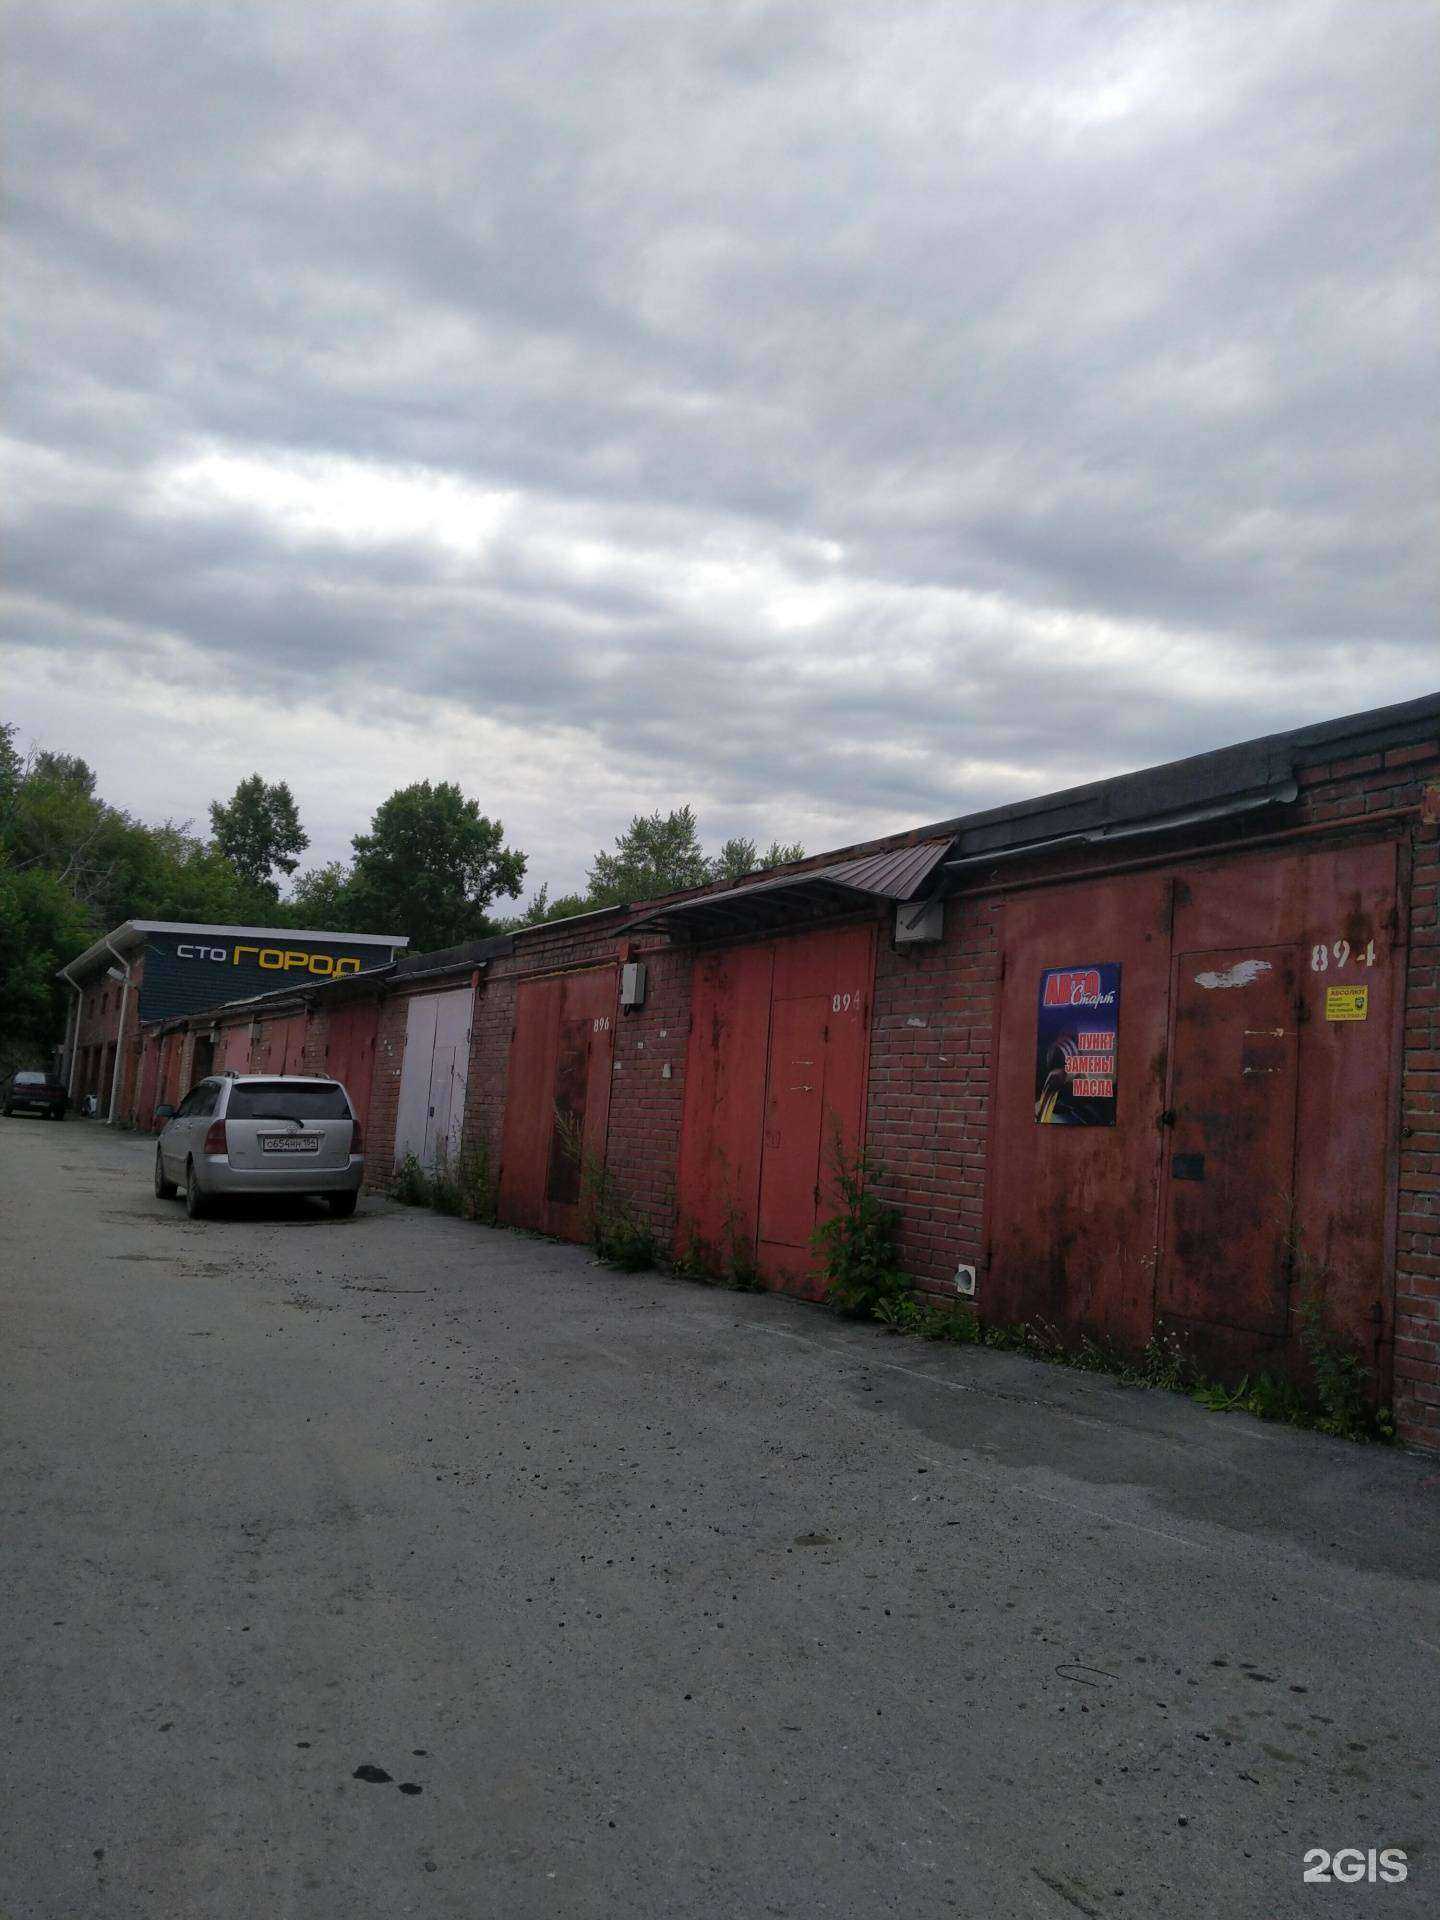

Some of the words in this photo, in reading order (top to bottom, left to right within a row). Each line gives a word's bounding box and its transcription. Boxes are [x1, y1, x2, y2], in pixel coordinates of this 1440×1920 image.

[177, 944, 227, 962] СТО
[233, 945, 361, 979] ГОРОД
[1311, 939, 1376, 971] 894
[1043, 970, 1101, 1007] АВТО
[1071, 984, 1116, 1010] Старт
[593, 1016, 610, 1033] 896
[1078, 1032, 1115, 1050] ПУНКТ
[1065, 1056, 1114, 1073] ЗАМЕНЫ
[1073, 1079, 1113, 1097] МАСЛА
